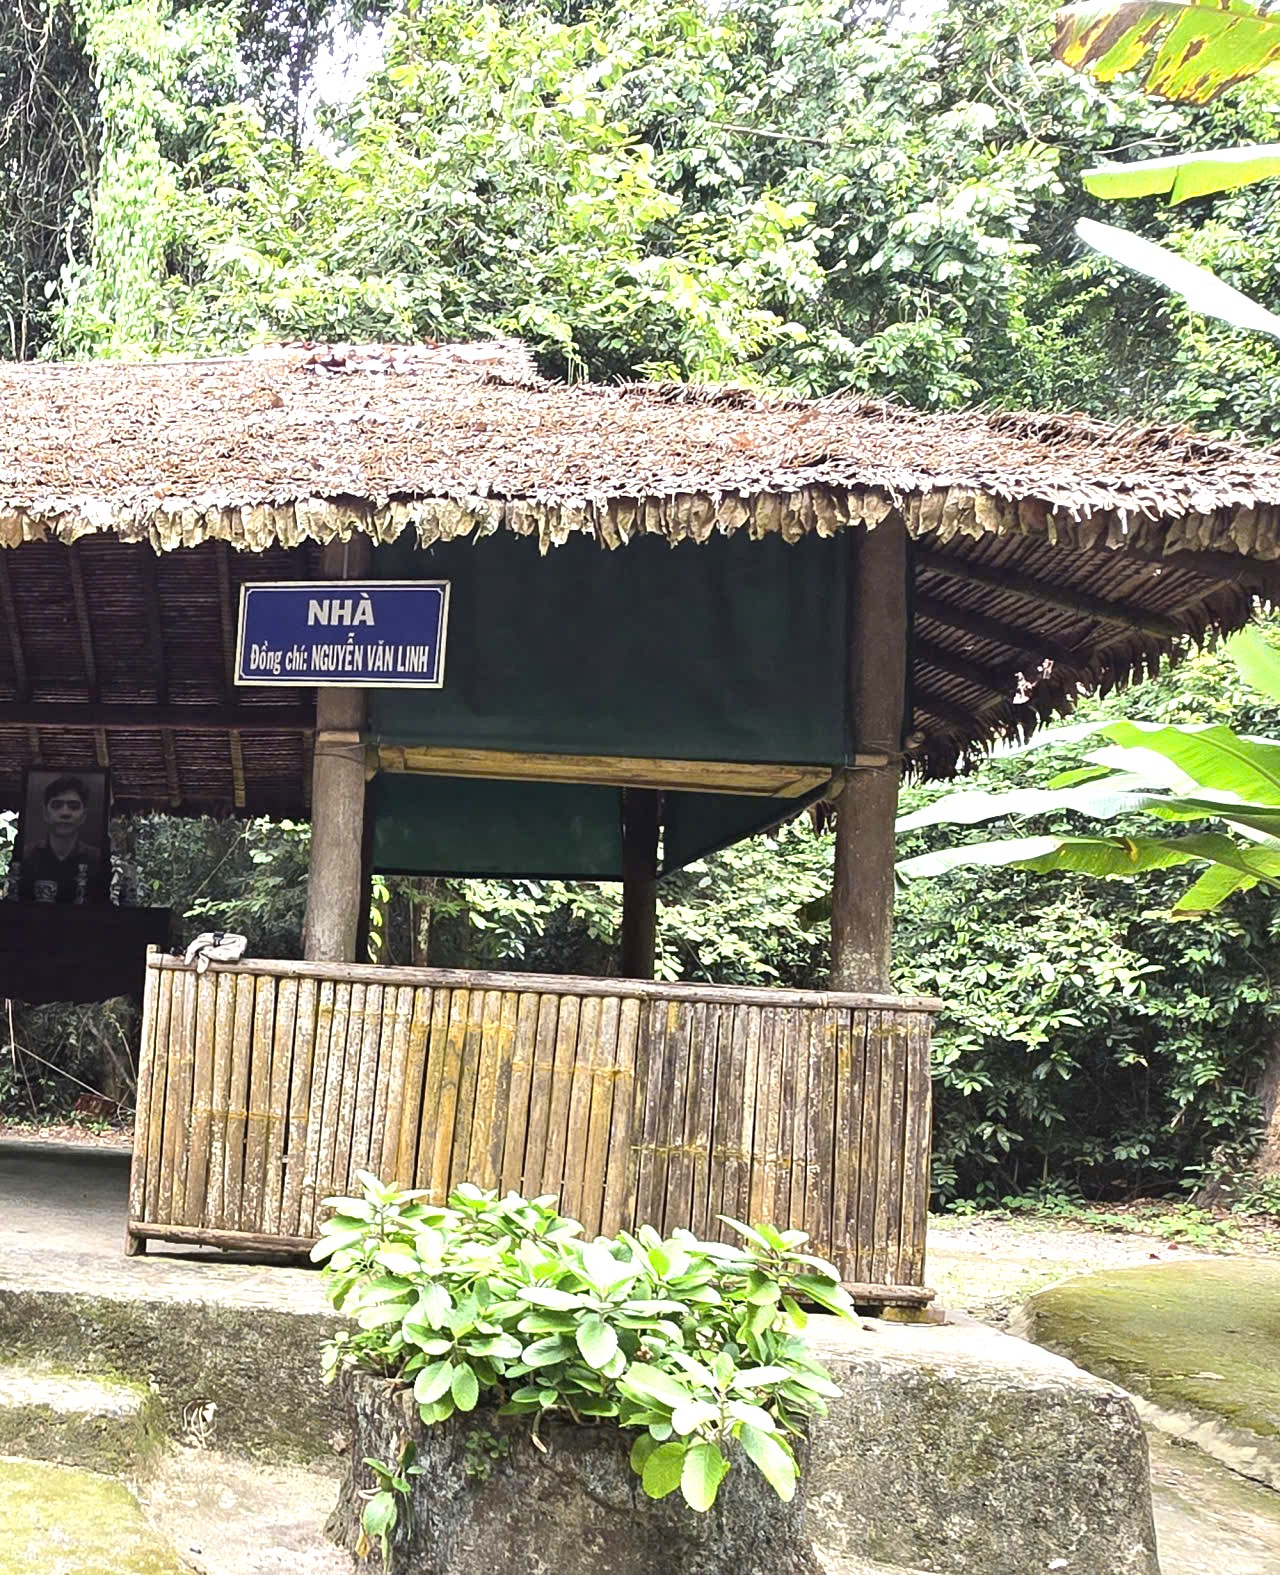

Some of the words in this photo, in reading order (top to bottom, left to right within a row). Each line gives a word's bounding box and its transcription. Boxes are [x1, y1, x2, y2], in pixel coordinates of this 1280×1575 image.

[307, 592, 375, 626] NHÀ
[250, 640, 283, 675] Đồng
[285, 643, 308, 672] chí:
[311, 632, 363, 672] NGUYỄN
[367, 640, 394, 672] VĂN
[397, 645, 429, 673] LINH
